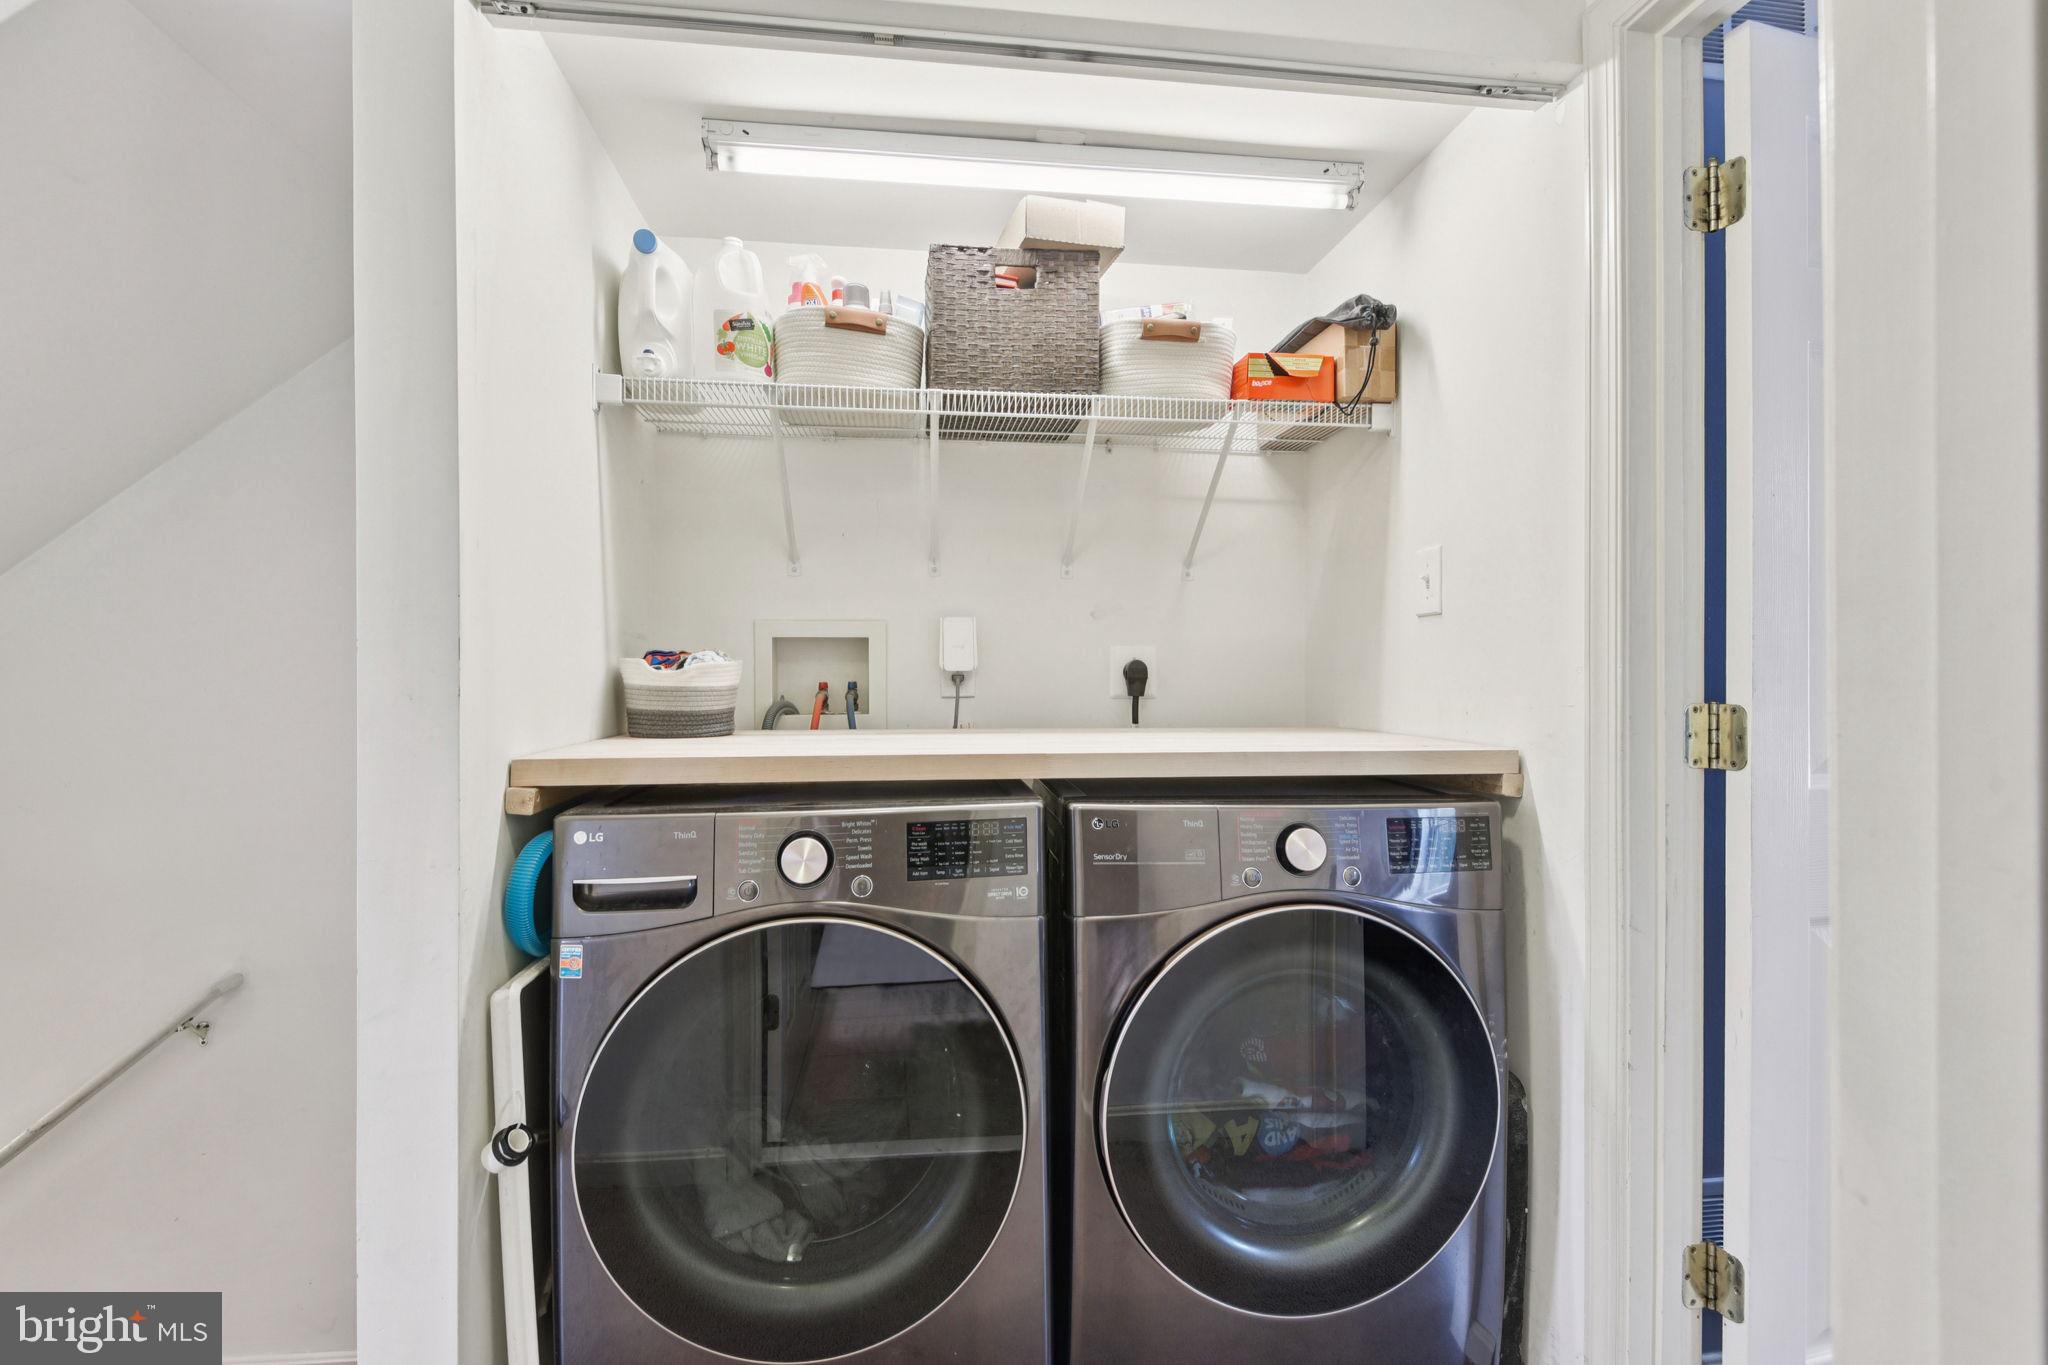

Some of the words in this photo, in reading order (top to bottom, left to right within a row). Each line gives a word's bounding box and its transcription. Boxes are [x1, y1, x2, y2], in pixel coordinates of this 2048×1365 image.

[1105, 819, 1120, 829] LG
[1182, 819, 1204, 828] ThinQ
[588, 833, 604, 842] LG
[673, 830, 697, 839] ThinQ
[1092, 853, 1128, 861] SensorDry
[1263, 1126, 1298, 1147] AND
